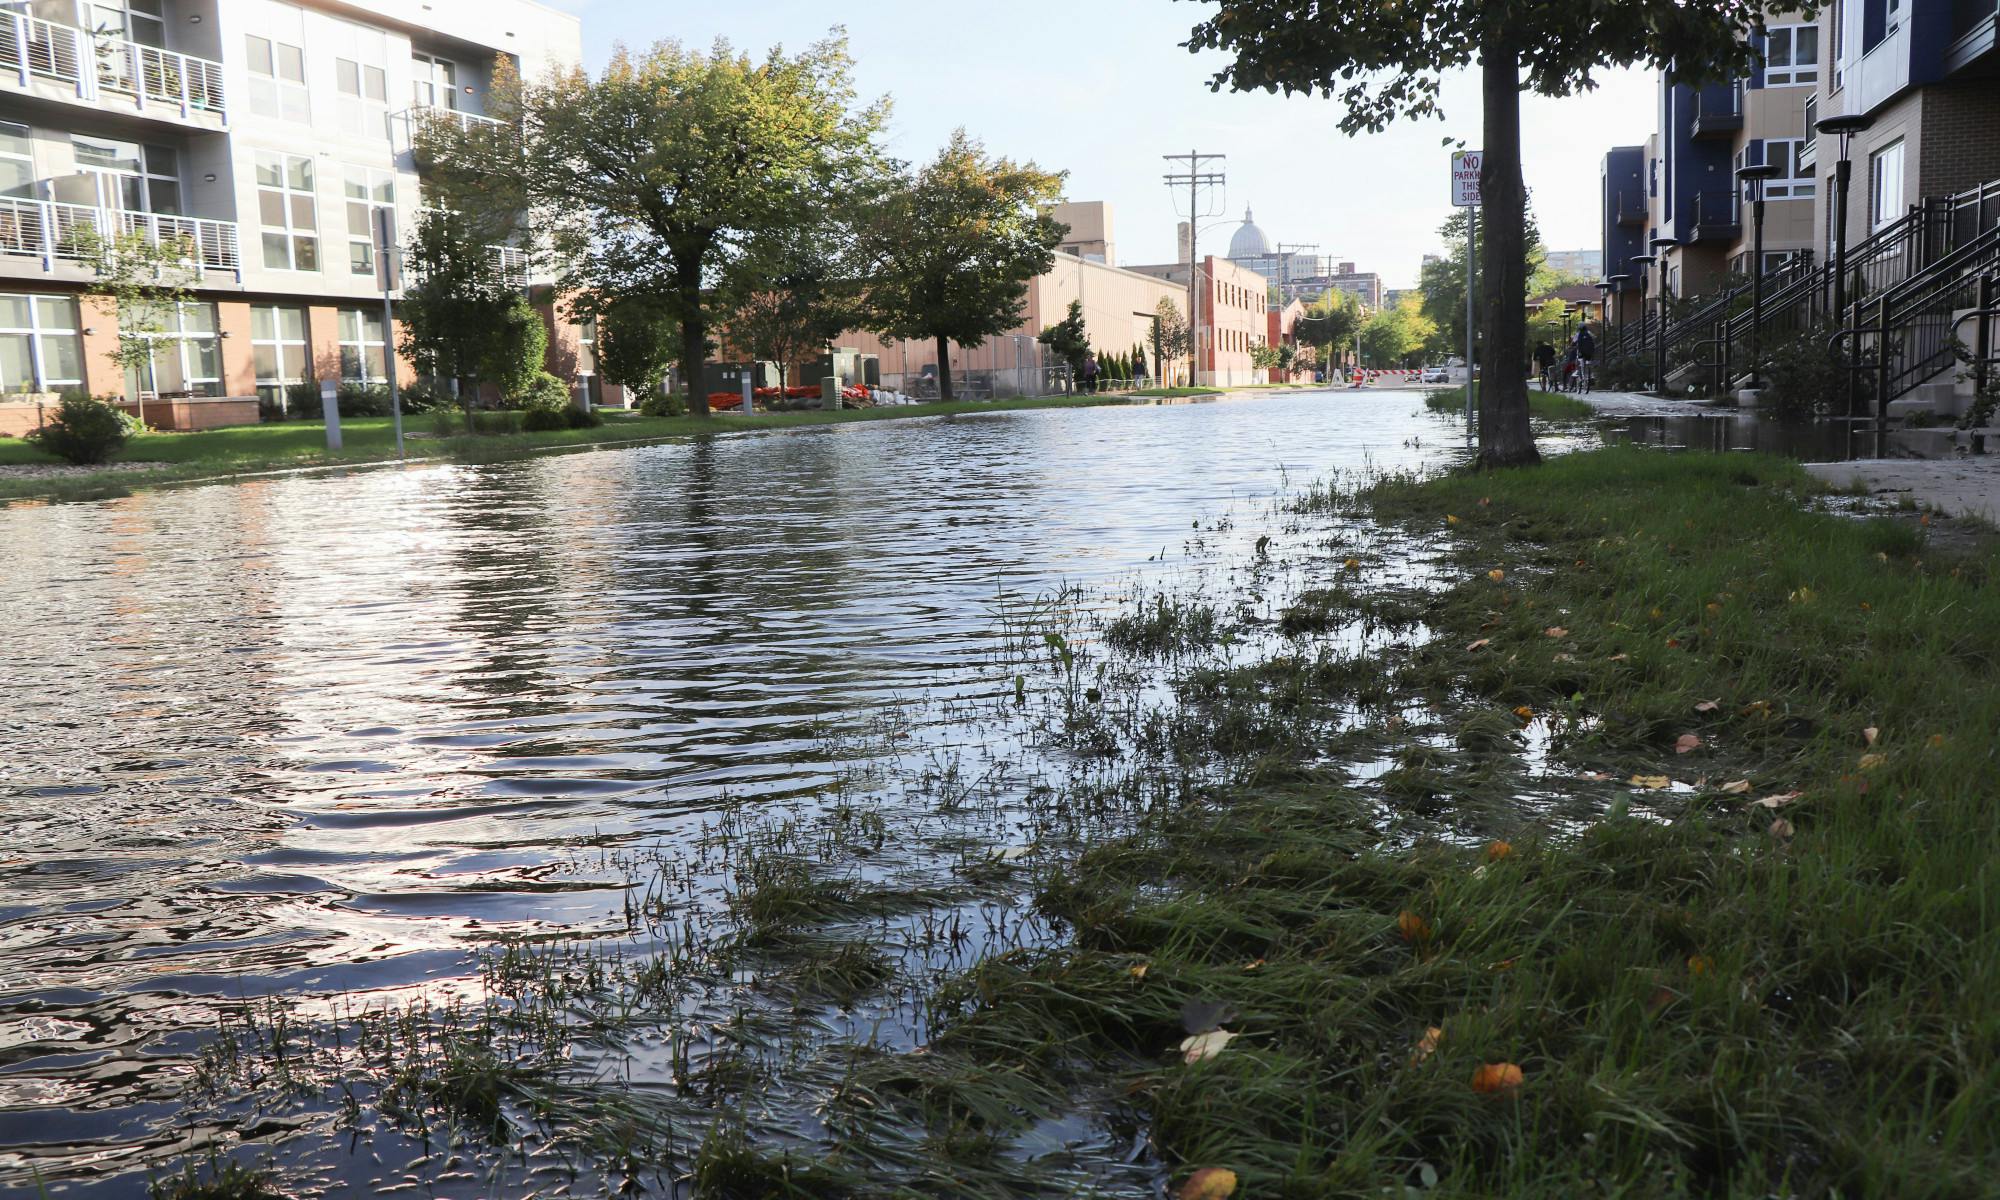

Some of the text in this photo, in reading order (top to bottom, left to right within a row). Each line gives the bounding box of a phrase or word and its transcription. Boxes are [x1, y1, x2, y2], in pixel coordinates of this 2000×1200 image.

[1463, 157, 1479, 169] NO
[1454, 171, 1482, 180] PARKIN
[1462, 181, 1480, 190] THIS
[1461, 192, 1481, 201] SIDE
